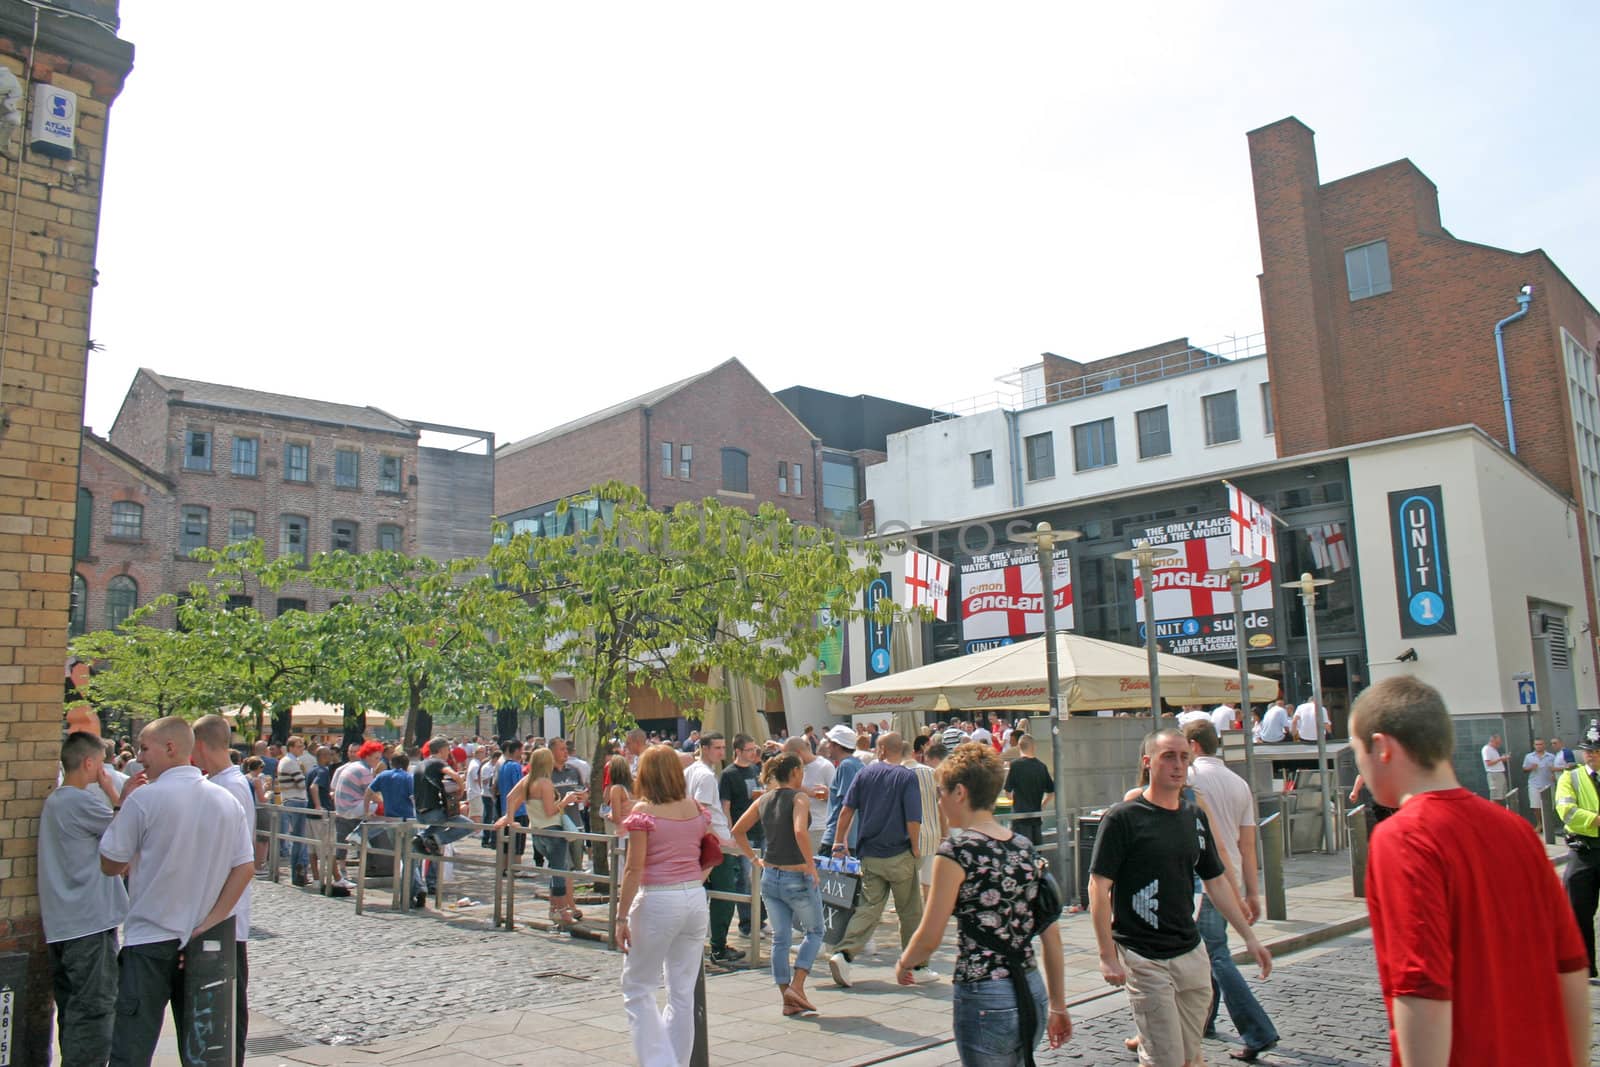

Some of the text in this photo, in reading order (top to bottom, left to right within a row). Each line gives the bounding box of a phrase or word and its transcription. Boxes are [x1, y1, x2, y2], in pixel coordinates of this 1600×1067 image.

[1145, 516, 1231, 537] THE ONLY PLACE
[1132, 525, 1231, 547] WATCH THE WORLD
[961, 562, 991, 573] WATCH
[992, 560, 1009, 569] THE
[971, 555, 988, 564] THE
[1409, 508, 1434, 618] UNIT 1
[968, 591, 1065, 613] enGLan!
[1156, 623, 1182, 636] NIT
[1213, 612, 1269, 631] sude
[1169, 640, 1175, 648] 2
[1177, 636, 1203, 647] LARGE
[1173, 645, 1191, 654] AND
[876, 654, 885, 669] 1
[853, 693, 914, 708] Budweiser
[975, 685, 1047, 701] Budweiser
